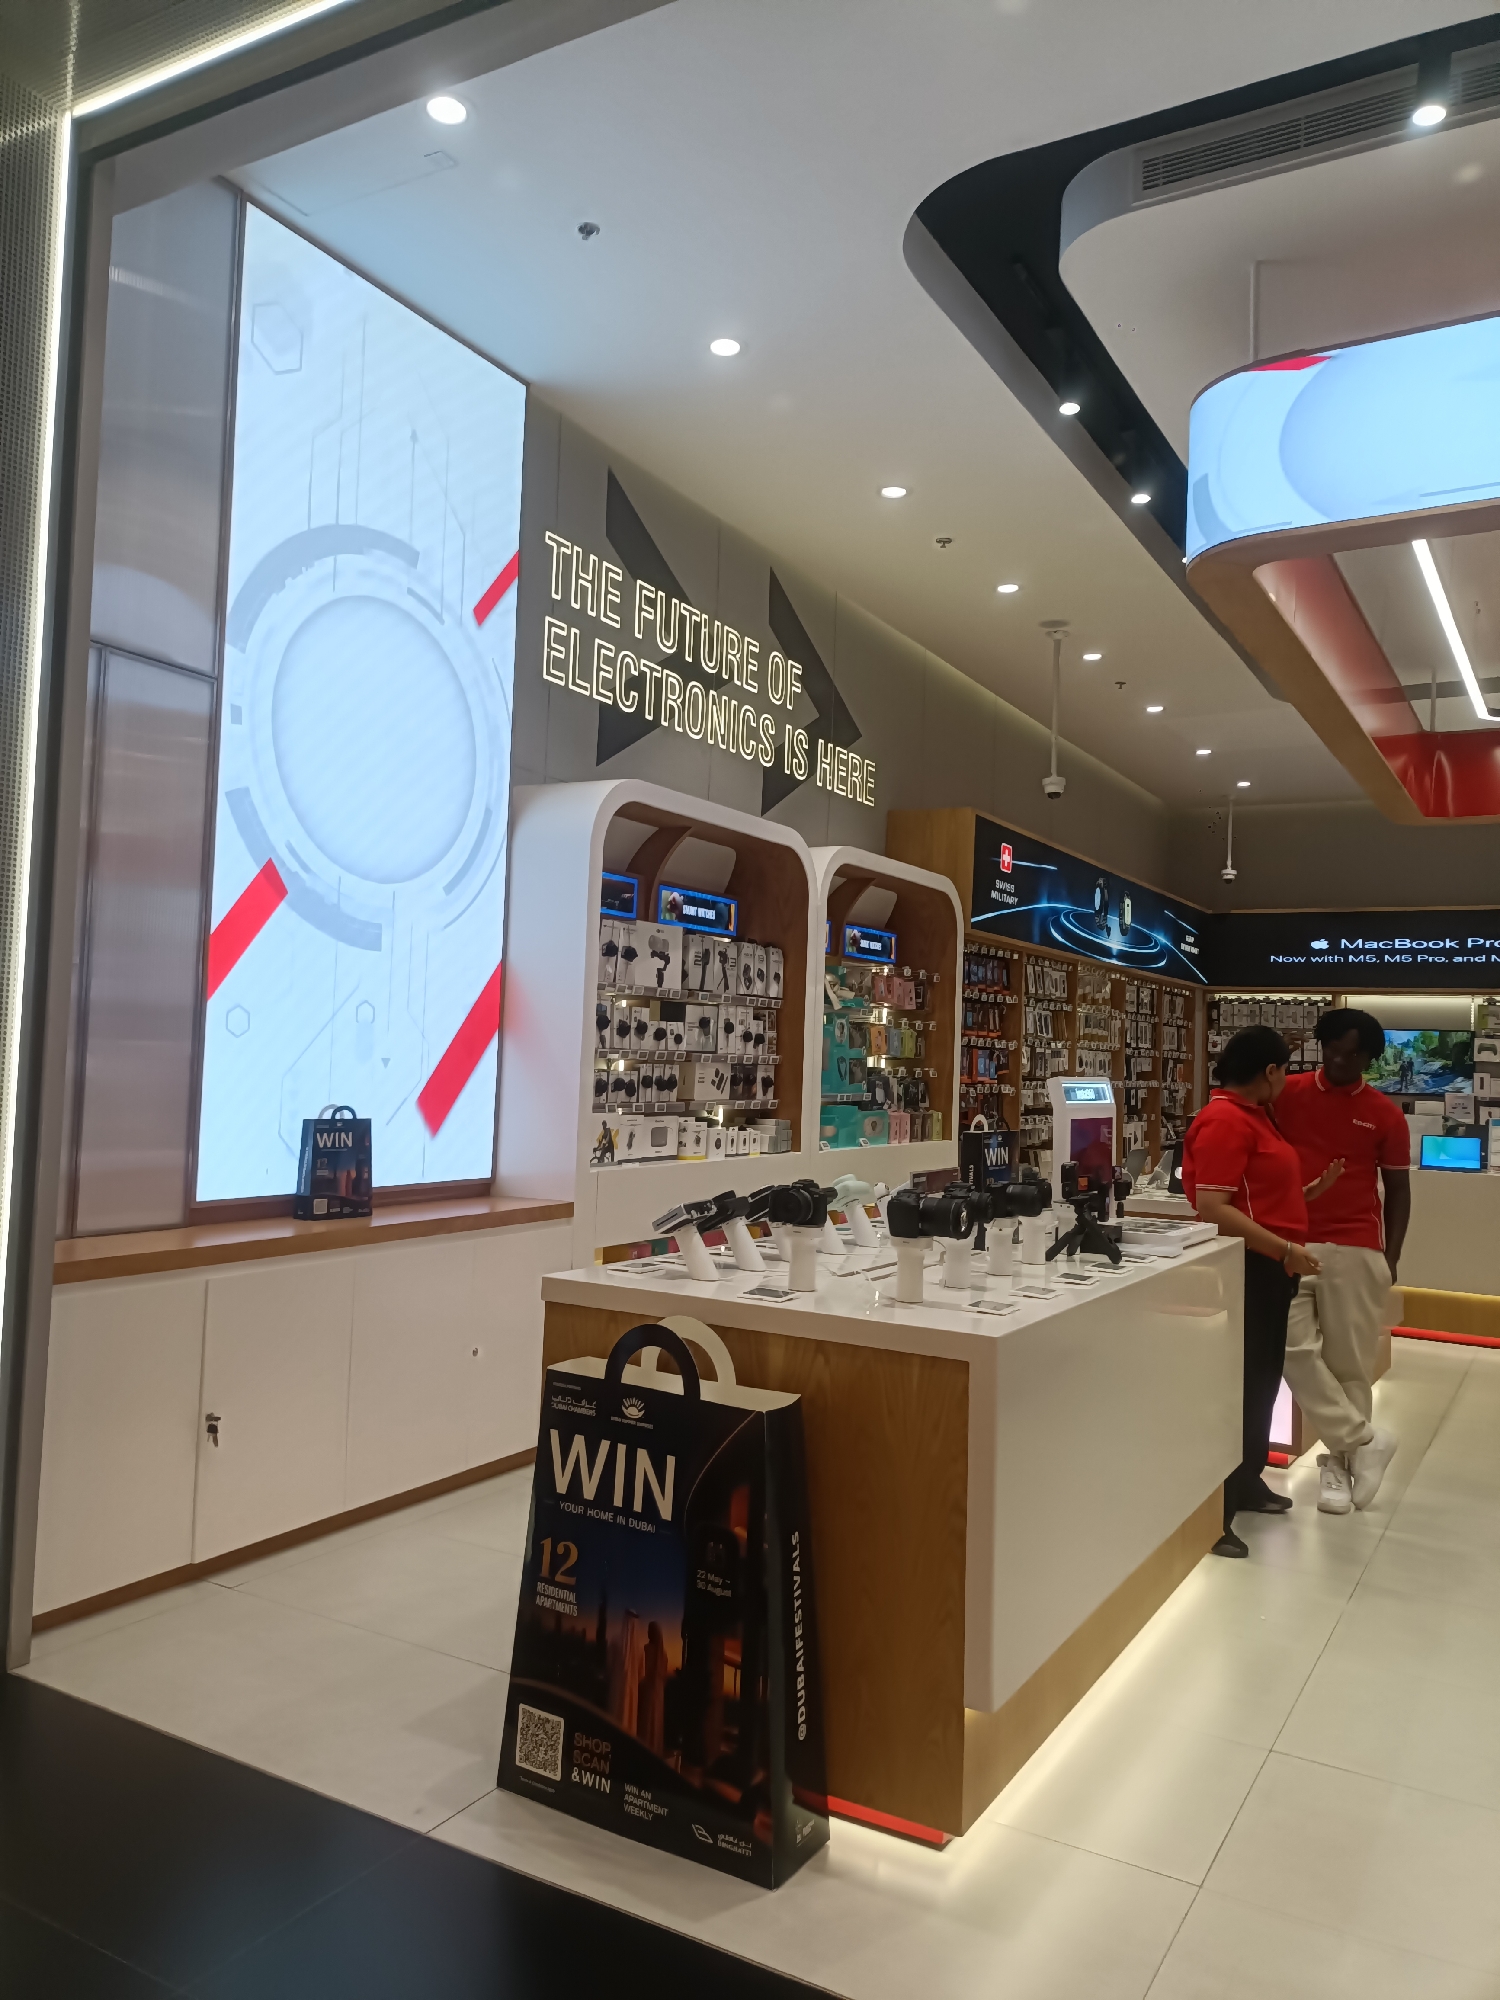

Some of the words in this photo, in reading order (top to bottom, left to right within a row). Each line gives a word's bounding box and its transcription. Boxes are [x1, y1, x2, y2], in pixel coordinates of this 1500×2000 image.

[545, 530, 623, 629] THE
[635, 580, 760, 693] FUTURE
[767, 650, 803, 710] OF
[543, 616, 776, 767] ELECTRONICS
[784, 724, 809, 781] IS
[816, 738, 876, 807] HERE
[990, 890, 1019, 906] MILITARY
[995, 879, 1015, 894] SWISS
[1340, 937, 1460, 949] MacBook
[1270, 954, 1307, 963] Now
[1310, 954, 1344, 963] with
[1348, 954, 1381, 964] M5,
[1384, 954, 1413, 963] M5
[1452, 954, 1486, 963] and
[316, 1131, 353, 1149] WIN
[984, 1147, 1009, 1167] WIN
[549, 1428, 676, 1522] WIN
[559, 1501, 585, 1515] YOUR
[587, 1508, 614, 1523] HOME
[616, 1515, 627, 1526] IN
[628, 1518, 656, 1534] DUBAI
[539, 1536, 579, 1586] 12
[707, 1573, 723, 1586] May
[536, 1581, 577, 1604] RESIDENTIAL
[535, 1594, 578, 1617] APARTMENTS
[791, 1531, 807, 1741] @DUBAIFESTIVALS
[572, 1750, 610, 1775] SCAN
[624, 1782, 639, 1796] WIN
[640, 1789, 652, 1801] AN
[623, 1794, 669, 1817] APARTMENT
[623, 1803, 654, 1821] WEEKLY
